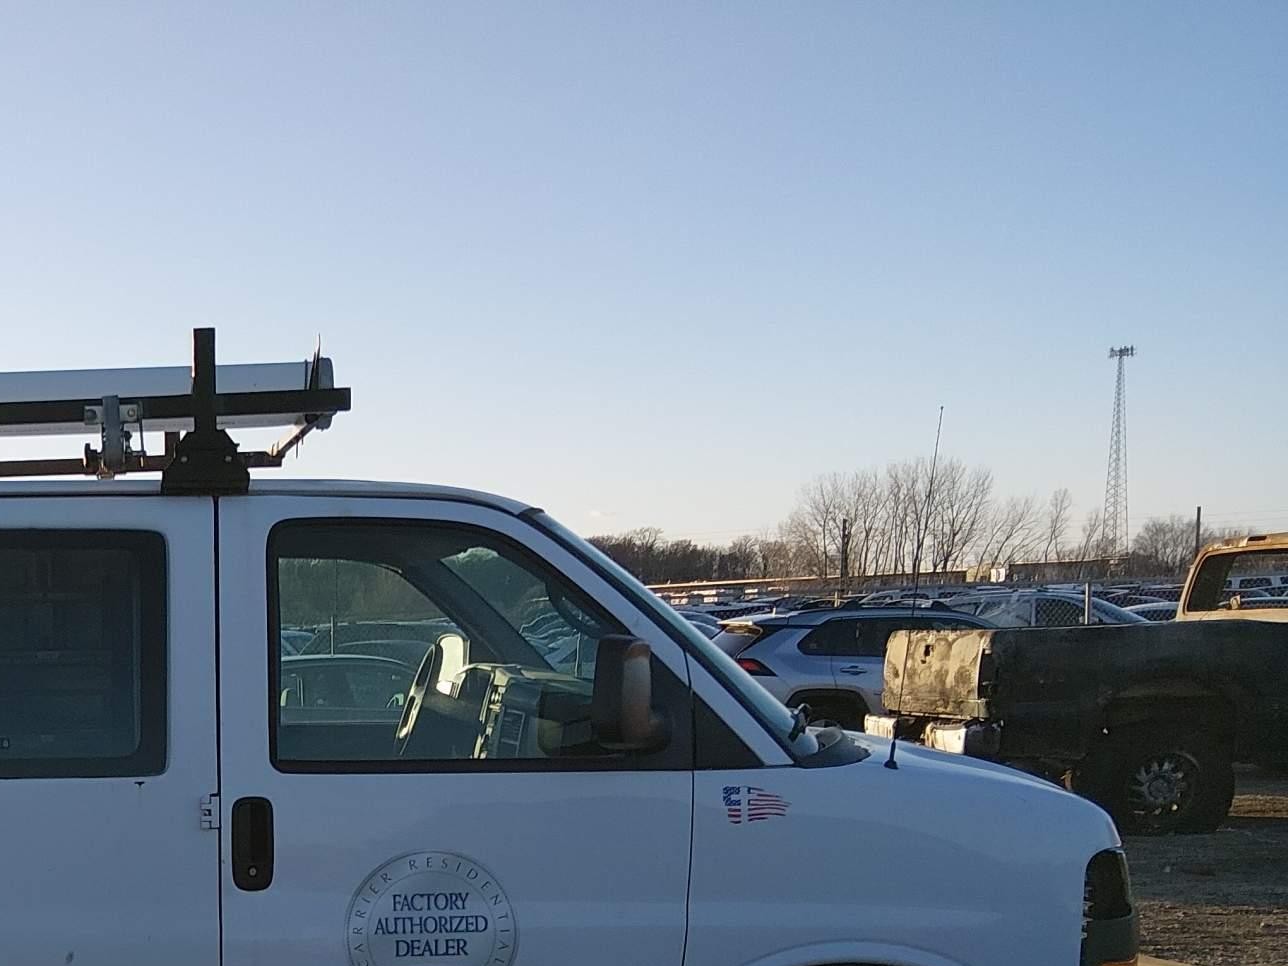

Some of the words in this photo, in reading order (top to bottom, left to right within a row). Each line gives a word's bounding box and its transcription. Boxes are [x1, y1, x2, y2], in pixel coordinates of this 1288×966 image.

[392, 893, 469, 911] FACTORY
[375, 915, 488, 935] AUTHORIZED
[396, 939, 468, 957] DEALER
